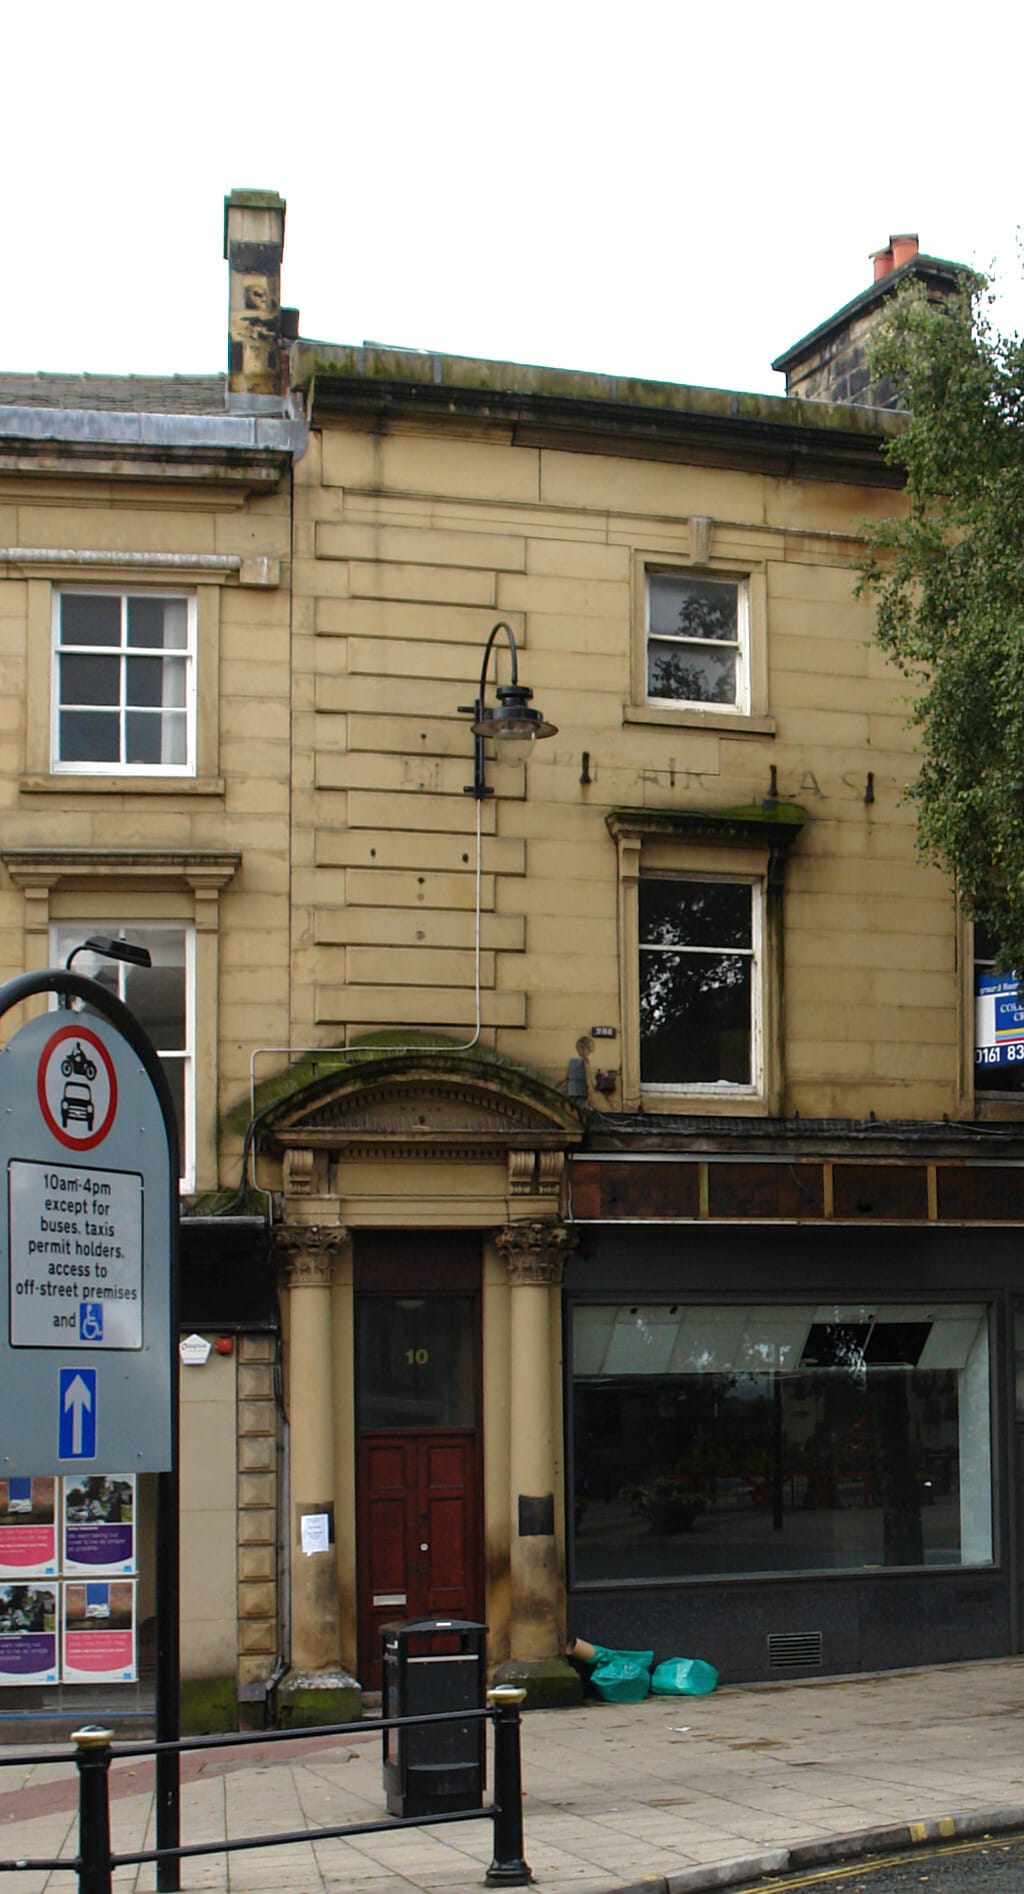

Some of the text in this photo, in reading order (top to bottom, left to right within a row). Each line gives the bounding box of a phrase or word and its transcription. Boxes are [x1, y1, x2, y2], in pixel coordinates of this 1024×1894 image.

[975, 1047, 1001, 1064] 0161
[44, 1173, 111, 1196] 10am-4pm
[44, 1198, 111, 1216] except for
[85, 1220, 115, 1237] taxis
[28, 1238, 71, 1255] permit
[48, 1262, 108, 1278] access to
[15, 1279, 138, 1301] off-street premises
[52, 1312, 76, 1328] and
[404, 1348, 429, 1365] 10
